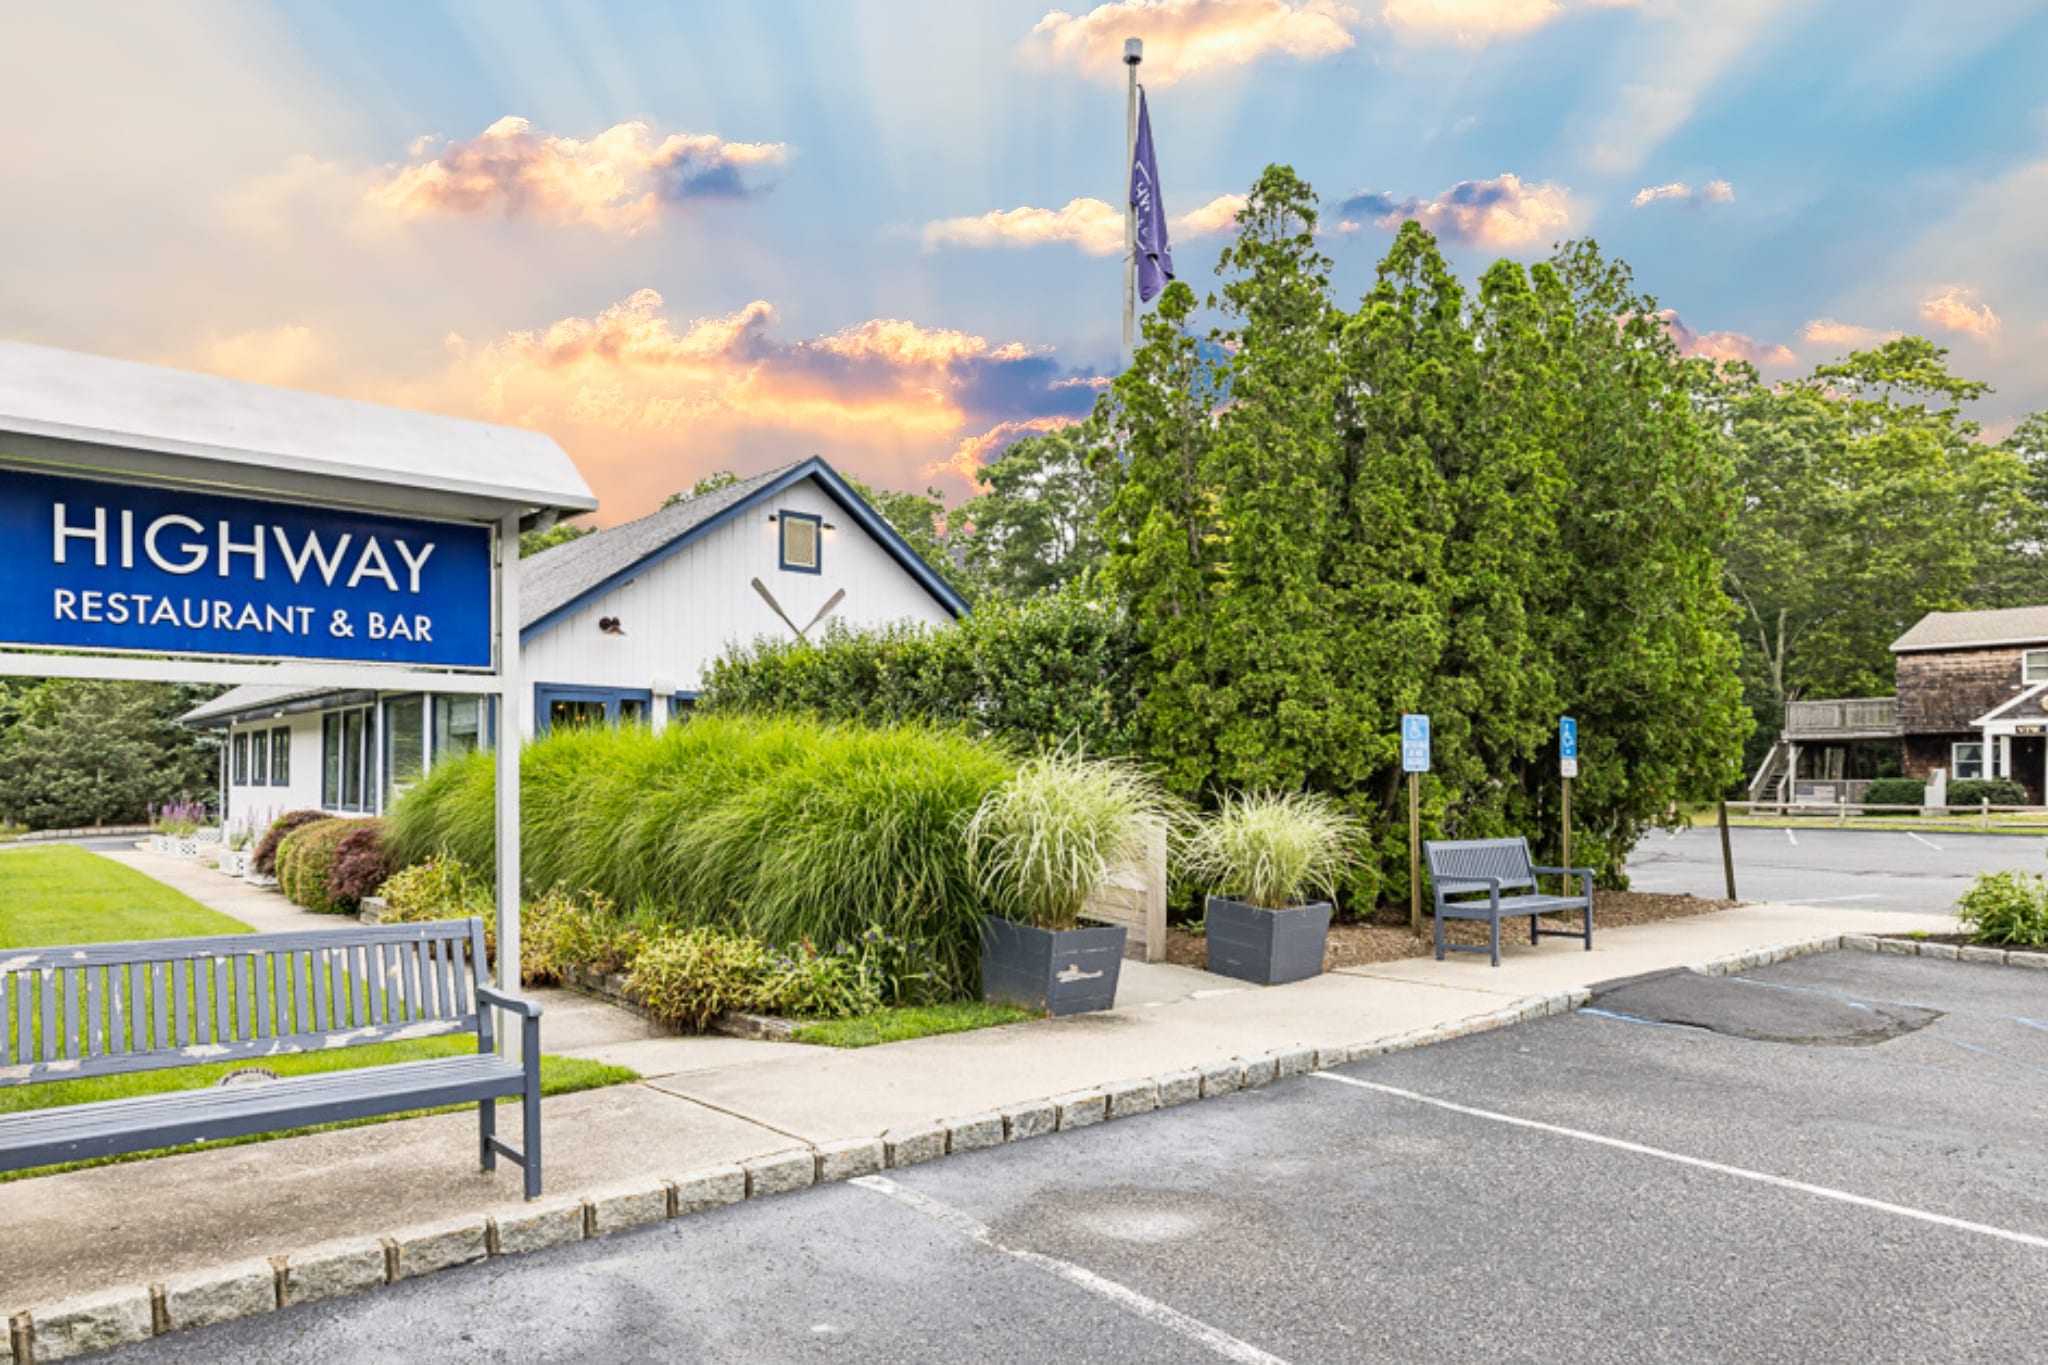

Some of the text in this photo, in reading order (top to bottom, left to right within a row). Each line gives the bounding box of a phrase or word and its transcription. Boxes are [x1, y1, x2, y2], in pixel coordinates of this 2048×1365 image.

[53, 503, 435, 593] HIGHWAY
[54, 588, 433, 642] RESTAURANT & BAR
